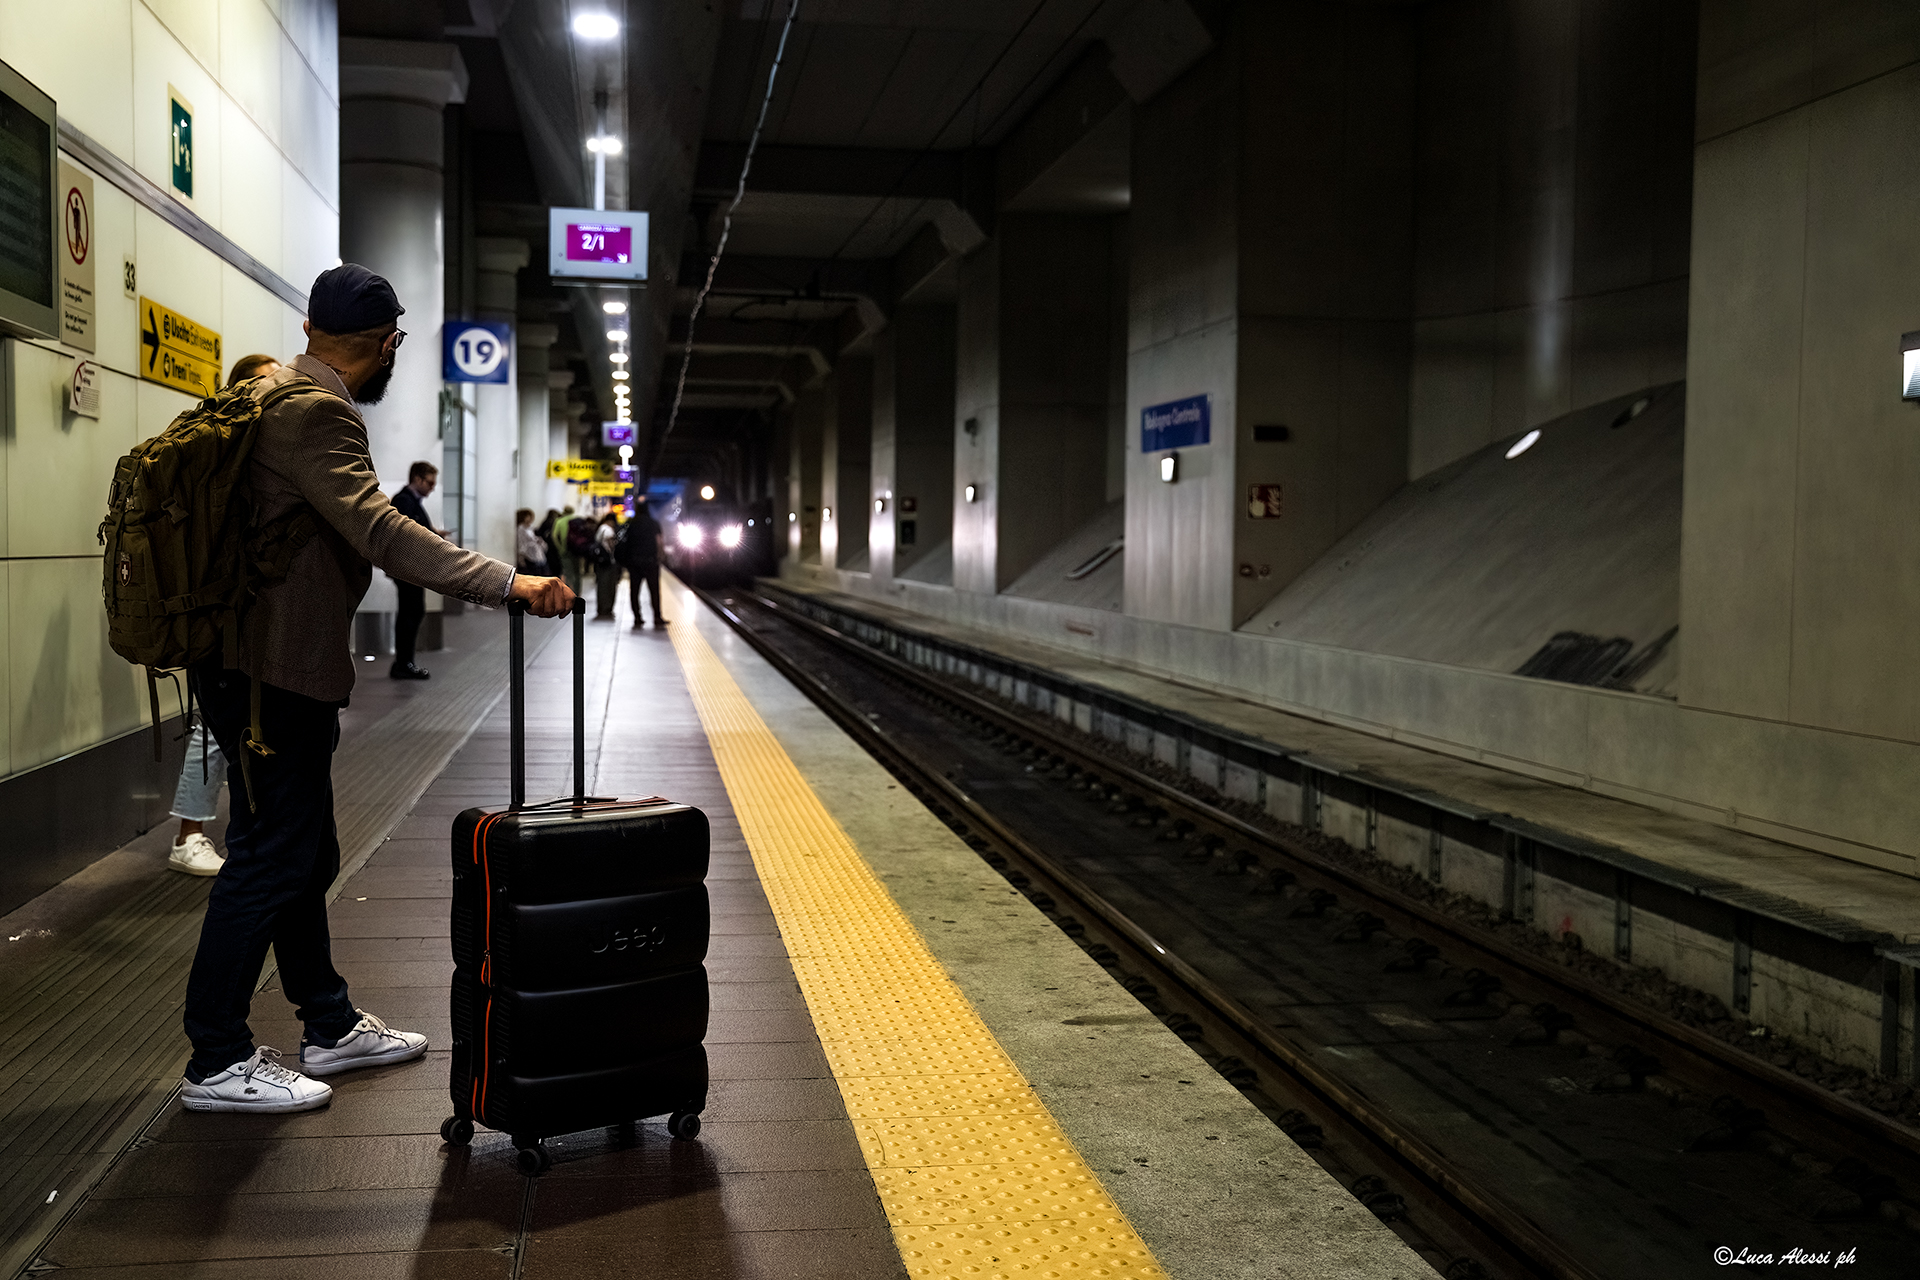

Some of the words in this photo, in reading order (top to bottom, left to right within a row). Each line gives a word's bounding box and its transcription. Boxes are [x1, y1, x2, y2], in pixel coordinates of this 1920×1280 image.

[581, 233, 605, 251] 2/1
[125, 260, 136, 292] 33
[460, 340, 494, 365] 19
[590, 924, 666, 953] Jeep
